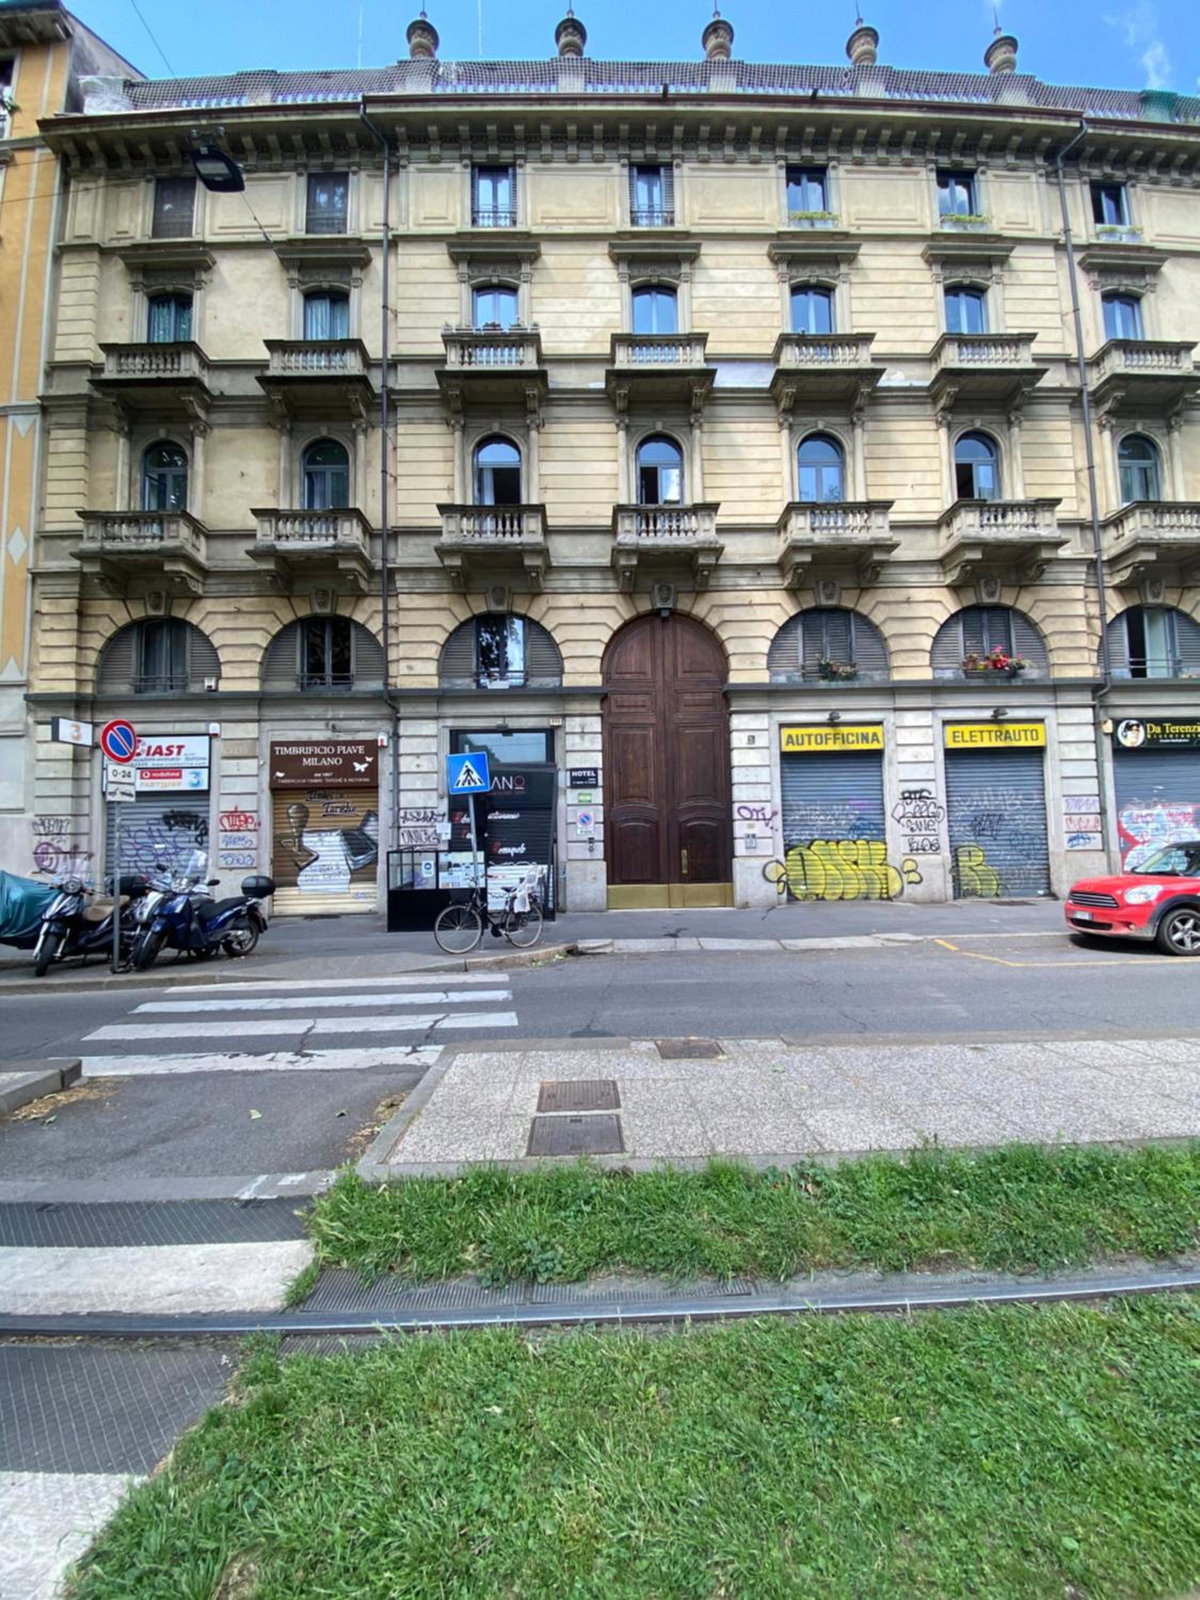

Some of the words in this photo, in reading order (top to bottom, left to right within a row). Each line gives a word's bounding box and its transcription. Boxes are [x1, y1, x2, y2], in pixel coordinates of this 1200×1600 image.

[1146, 723, 1161, 734] Da
[785, 731, 881, 747] AUTOFFICINA
[952, 728, 1039, 743] ELETTRAUTO
[274, 746, 335, 755] TIMBRIFICIO
[337, 745, 365, 754] PIAVE
[303, 757, 342, 766] MILANO
[112, 769, 131, 778] 0-24
